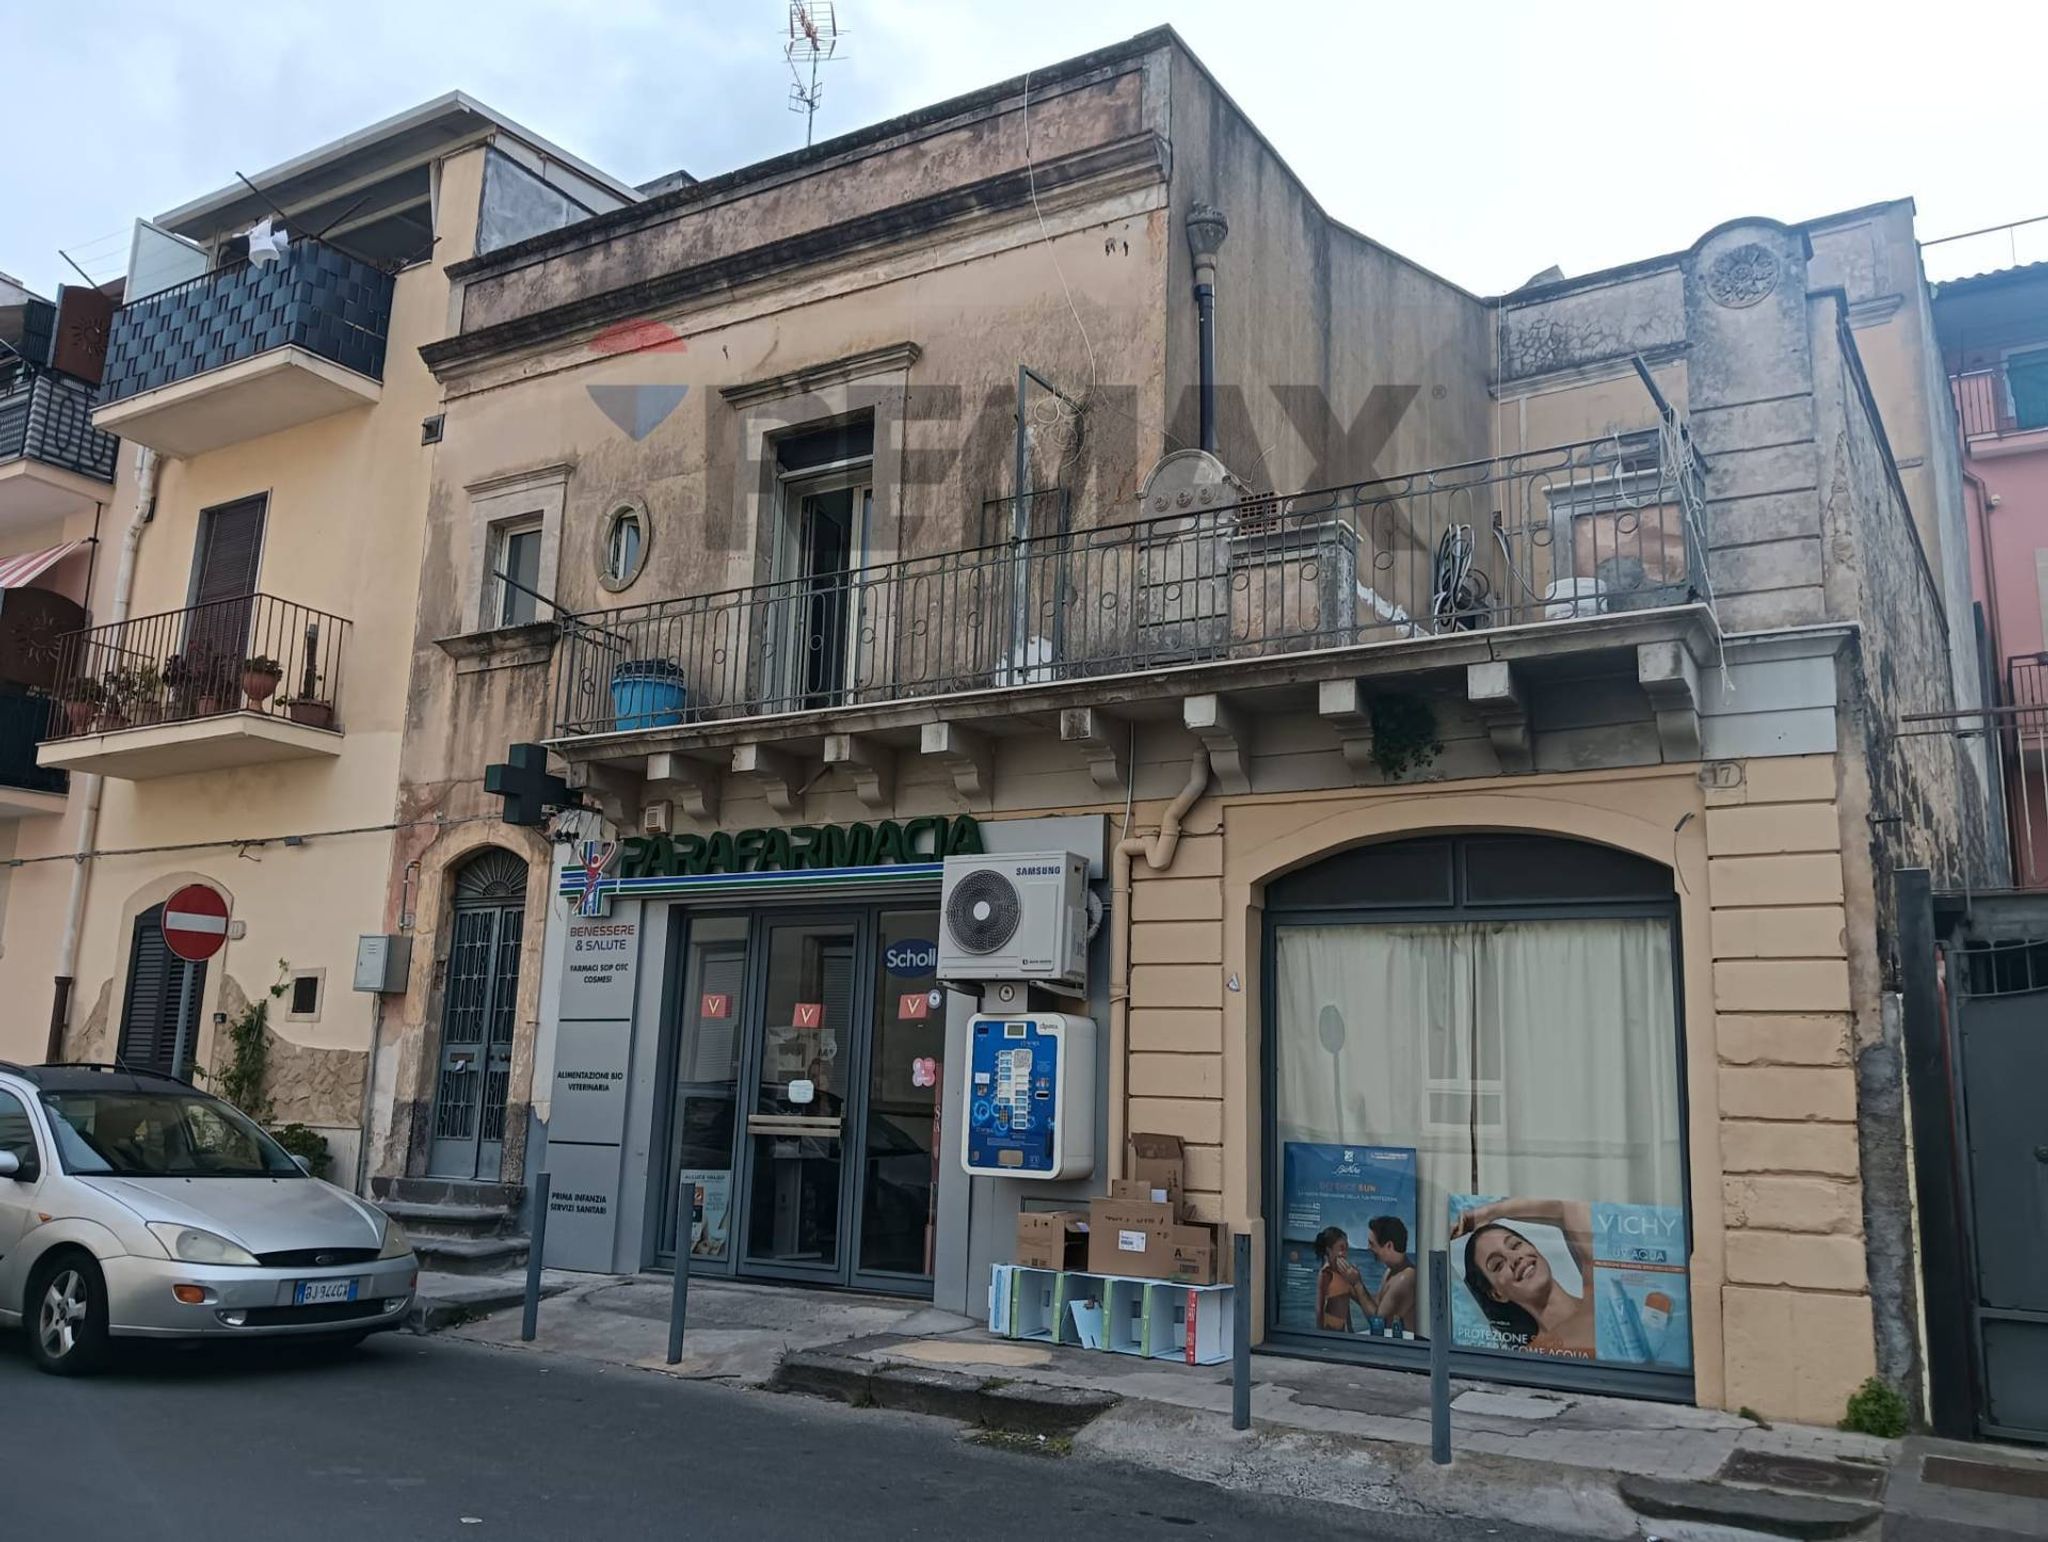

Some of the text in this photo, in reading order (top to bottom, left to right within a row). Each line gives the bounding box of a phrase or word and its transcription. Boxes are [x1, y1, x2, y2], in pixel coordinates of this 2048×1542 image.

[620, 814, 984, 878] PARAFARMACIA
[1016, 866, 1061, 876] SAMSUNG
[570, 925, 635, 937] BENESSERE
[575, 939, 627, 951] & SALUTE
[886, 948, 936, 967] Scholl
[570, 964, 599, 972] FARMACI
[584, 976, 613, 984] COSMESI
[557, 1071, 624, 1080] ALIMENTAZIONE BIO
[568, 1083, 610, 1092] VETERINARIA
[552, 1192, 607, 1203] PRIMA INFANZIA
[550, 1203, 607, 1215] SERVIZI SANITARI
[1598, 1214, 1676, 1236] VICHY
[1458, 1327, 1528, 1344] PROTEZIONE
